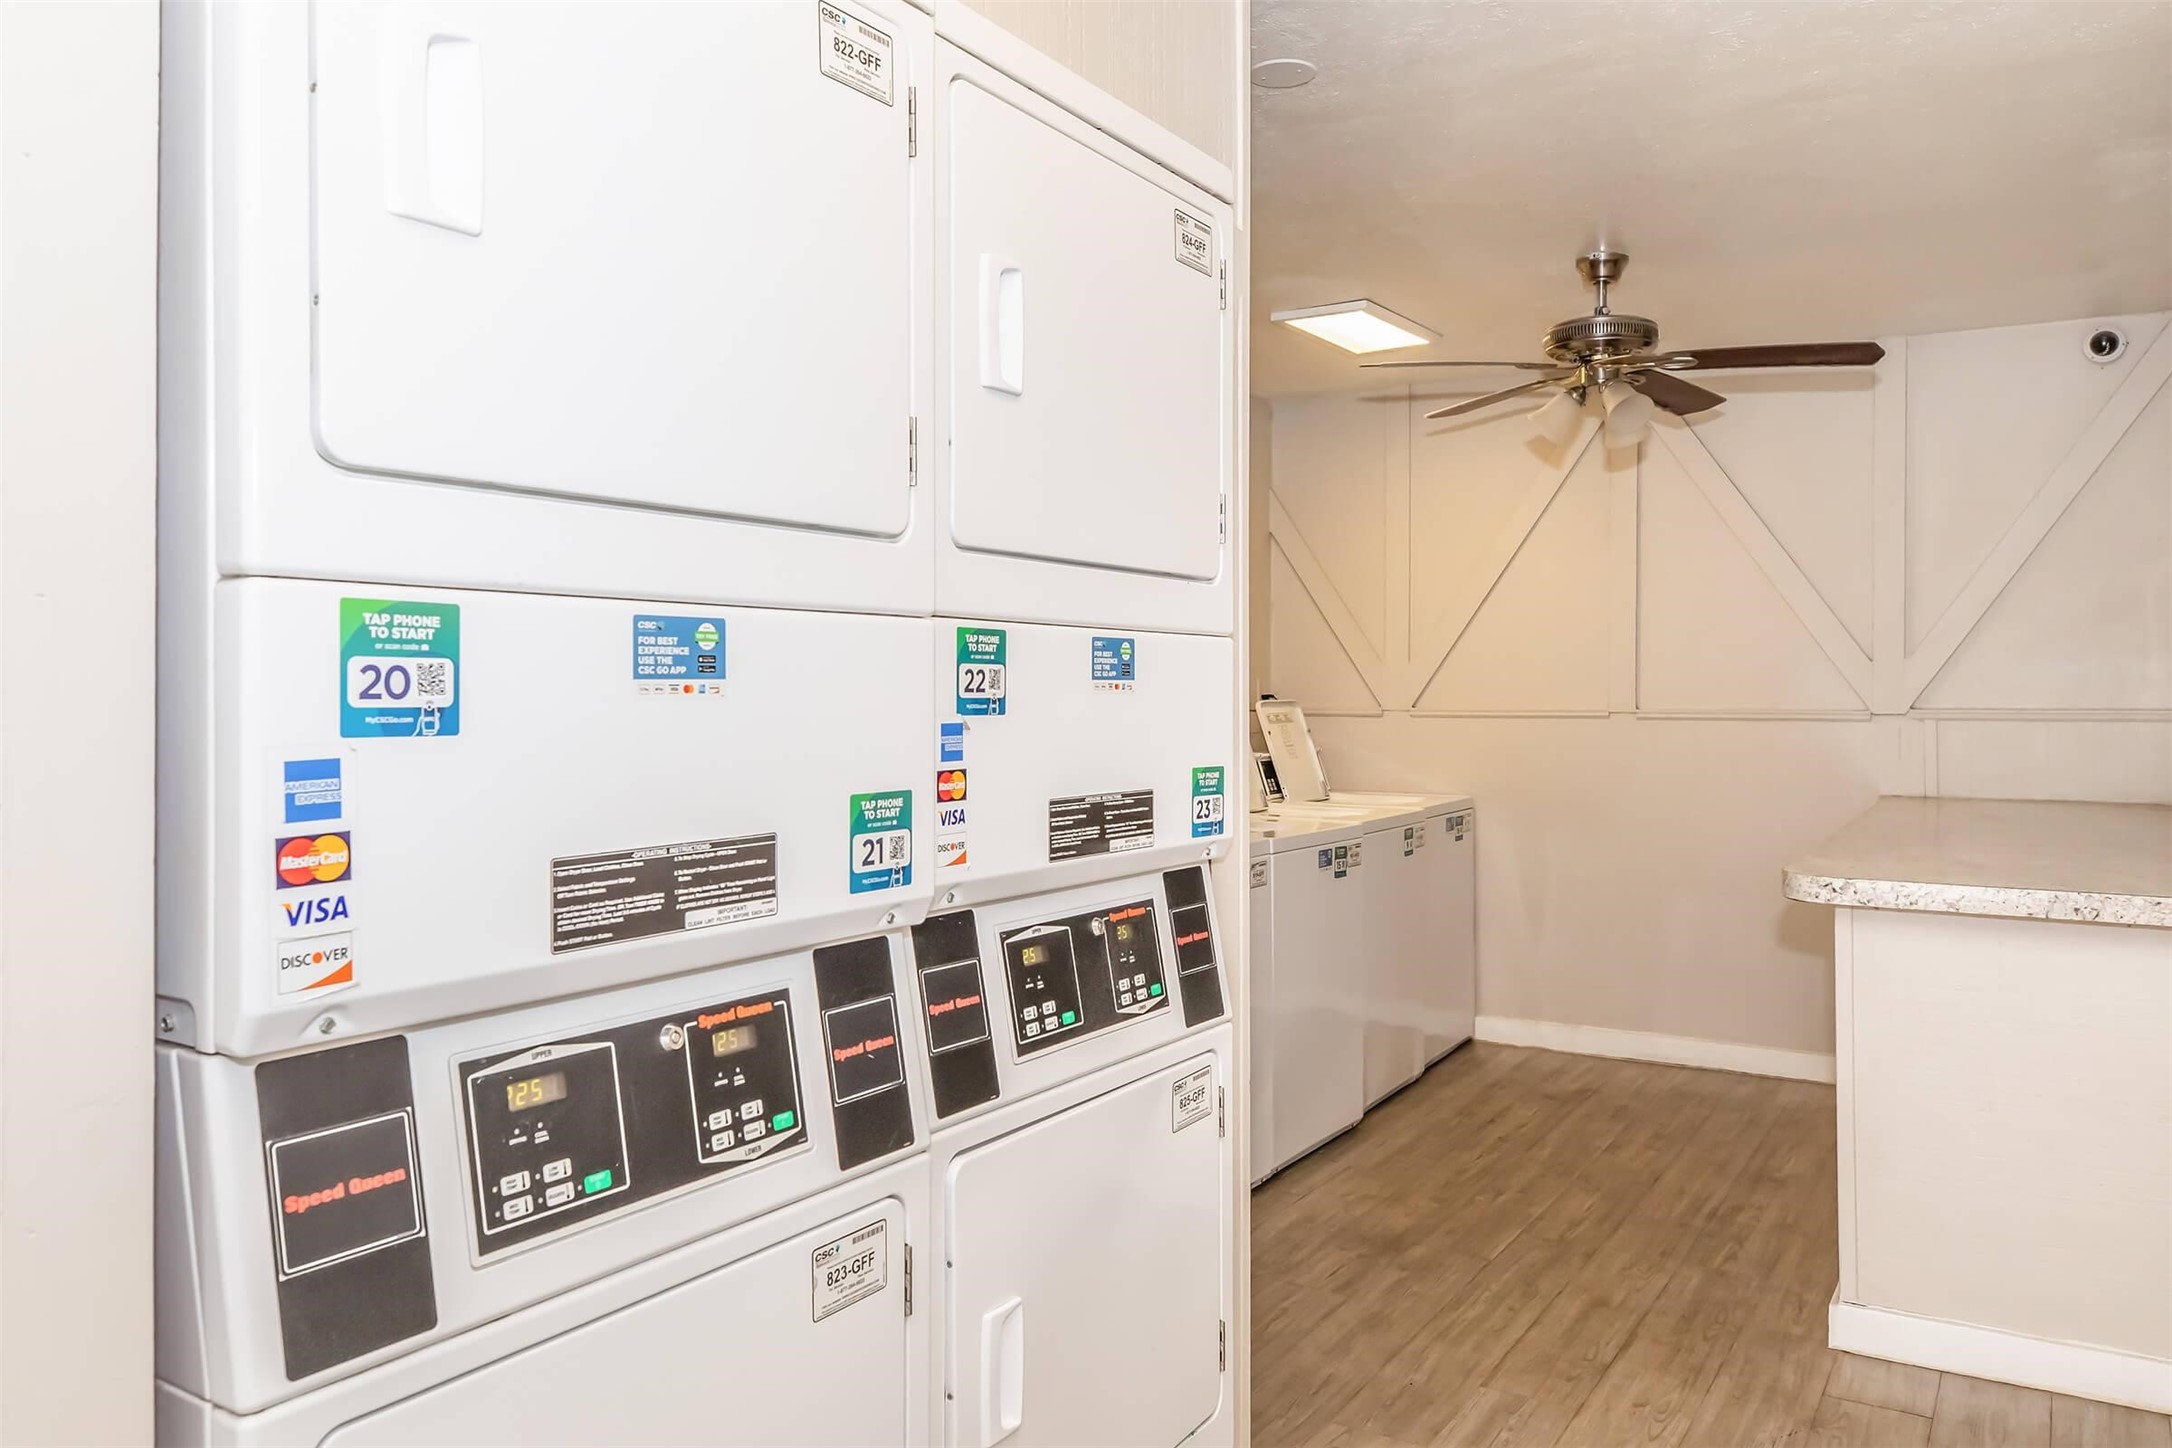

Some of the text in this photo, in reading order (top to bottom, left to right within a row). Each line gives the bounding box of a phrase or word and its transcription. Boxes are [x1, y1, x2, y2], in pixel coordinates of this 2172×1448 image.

[822, 7, 840, 22] CSC
[833, 37, 881, 71] 822-GFF
[362, 613, 441, 628] TAP PHONE
[637, 621, 657, 629] CSC
[368, 626, 435, 640] TO START
[638, 636, 678, 645] FOR BEST
[965, 634, 999, 644] TAP PHONE
[638, 646, 690, 655] EXPERIENCE
[968, 644, 997, 652] TO START
[638, 656, 673, 664] USE THE
[638, 666, 687, 674] CSC GO APP
[359, 664, 411, 700] 20
[964, 668, 986, 693] 22
[285, 780, 338, 791] AMERICAN
[296, 792, 342, 804] EXPRESS
[861, 797, 904, 810] TAP PHONE
[864, 808, 900, 820] TO START
[1196, 799, 1211, 819] 23
[938, 808, 966, 827] VISA
[862, 837, 883, 867] 21
[938, 842, 965, 853] DISCOVER
[279, 850, 348, 871] MasterCard
[282, 896, 349, 927] VISA
[281, 947, 349, 970] DISCOVER
[929, 994, 981, 1017] Speed Queen
[698, 1001, 774, 1029] Speed Queen
[531, 1049, 552, 1060] UPPER
[833, 1035, 894, 1062] Speed Queen
[744, 1145, 762, 1157] LOWER
[284, 1168, 406, 1213] Speed Queen
[815, 1247, 835, 1262] CSC
[826, 1250, 876, 1287] 823-GFF
